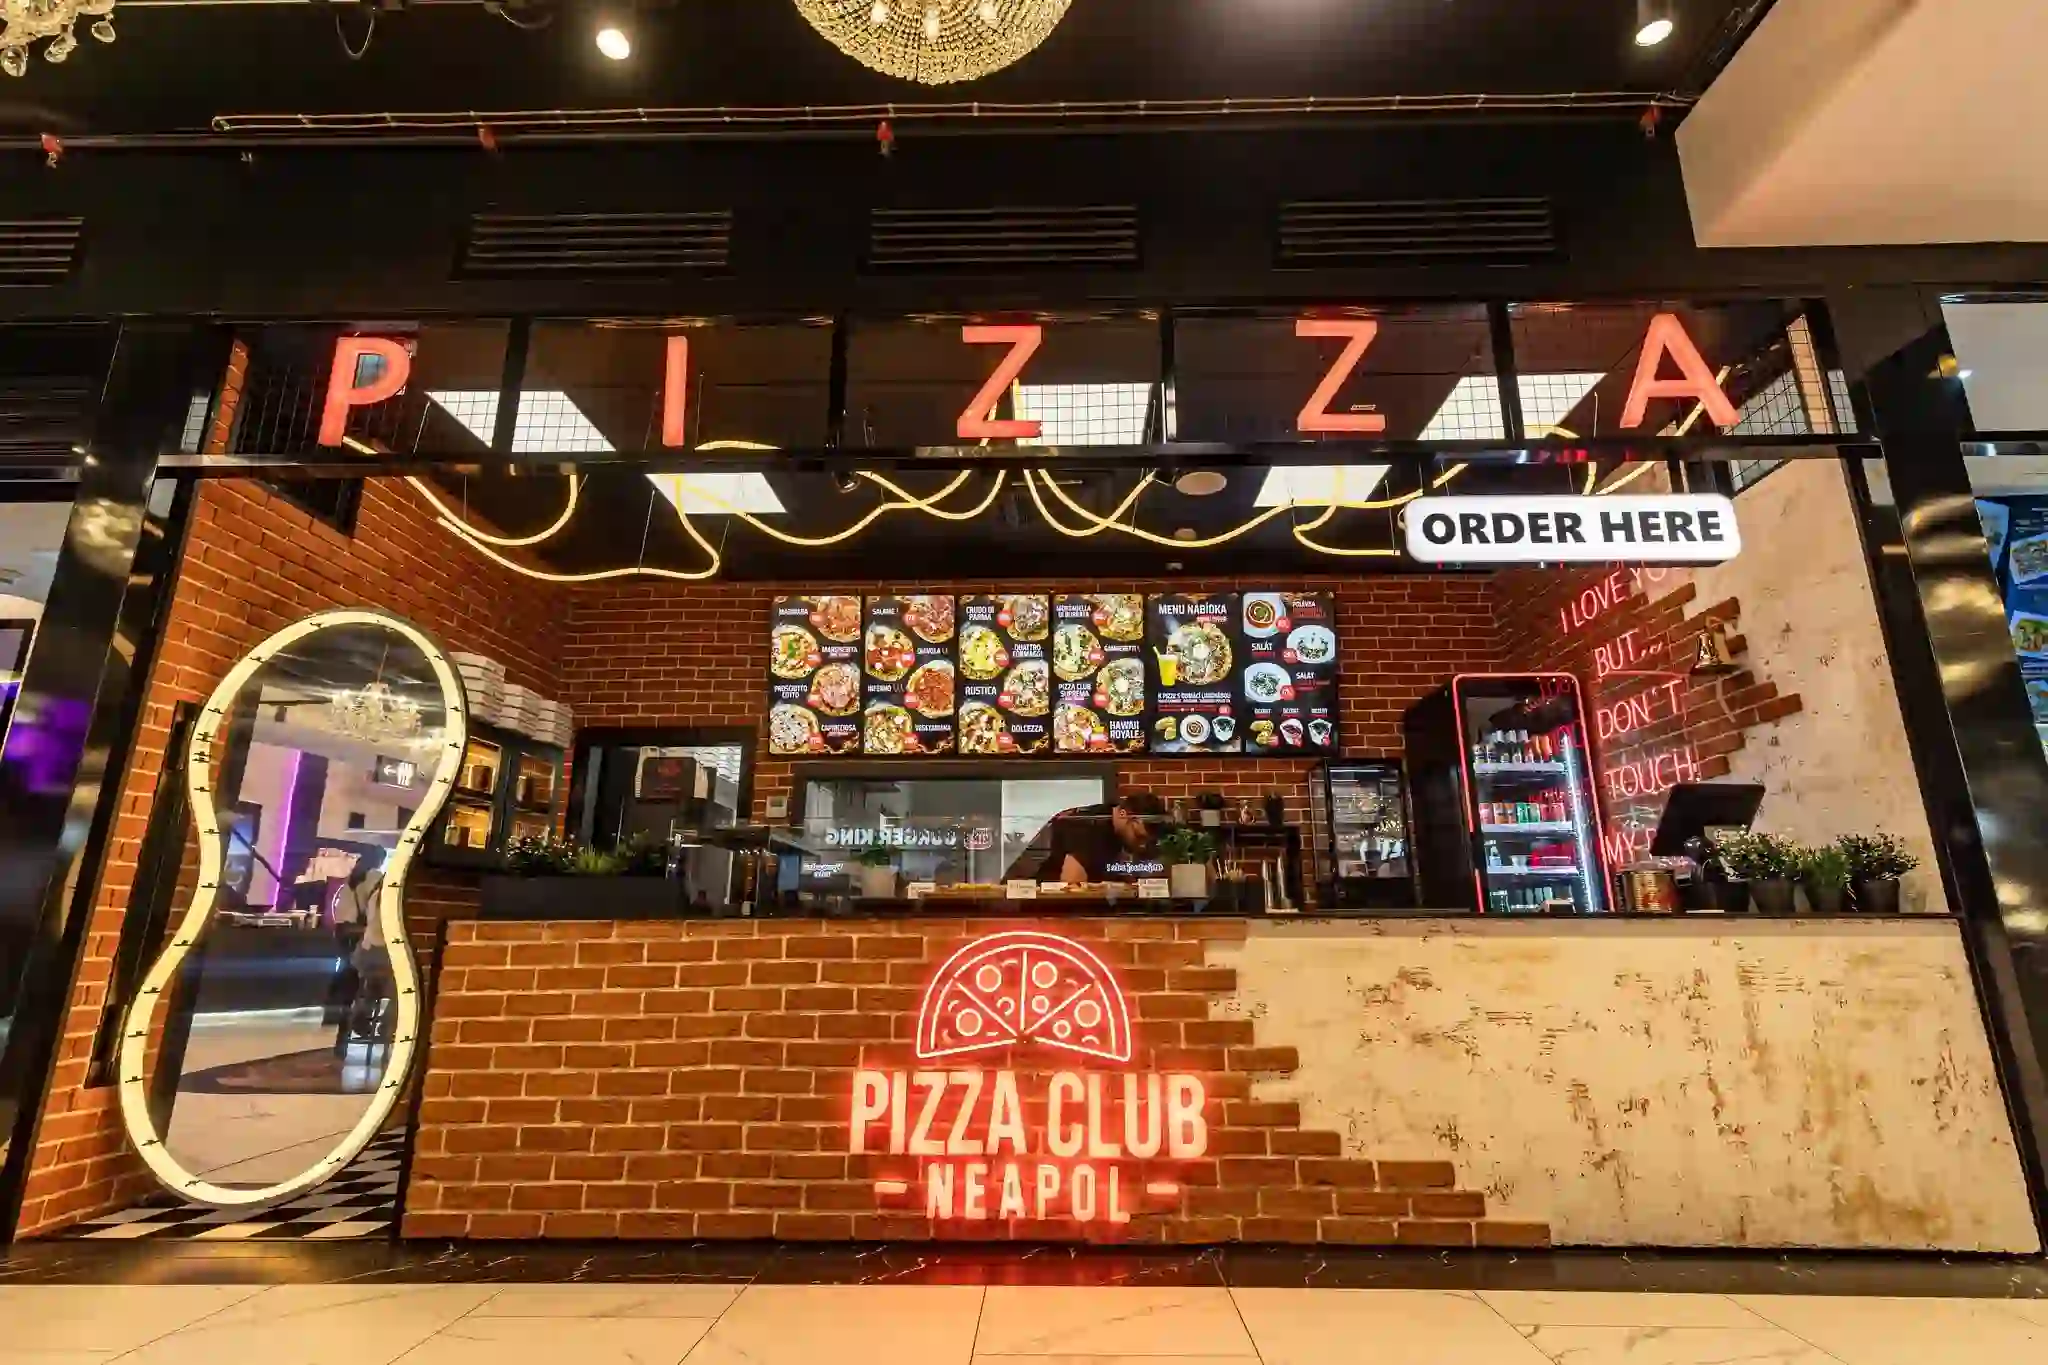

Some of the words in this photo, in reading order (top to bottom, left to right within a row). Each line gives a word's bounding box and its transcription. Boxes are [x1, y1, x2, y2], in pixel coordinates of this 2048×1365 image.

[317, 313, 1741, 447] PIZZA
[1422, 512, 1586, 545] ORDER
[1599, 511, 1725, 543] HERE
[1158, 603, 1185, 614] MENU
[1187, 602, 1227, 614] NABÍDKA
[1560, 607, 1568, 635] I
[1571, 570, 1627, 628] LOVE
[1014, 643, 1042, 651] QUATTRO
[1251, 641, 1273, 651] SALÁT
[965, 686, 997, 696] RUSTICA
[1058, 683, 1076, 691] PIZZA
[1597, 680, 1684, 740] DON'T
[1011, 724, 1044, 733] DOLCEZZA
[1109, 730, 1139, 739] ROYALE
[1604, 828, 1637, 865] MY
[849, 1069, 1028, 1156] PIZZA
[1046, 1070, 1209, 1159] CLUB
[925, 1162, 1131, 1224] NEAPOL
